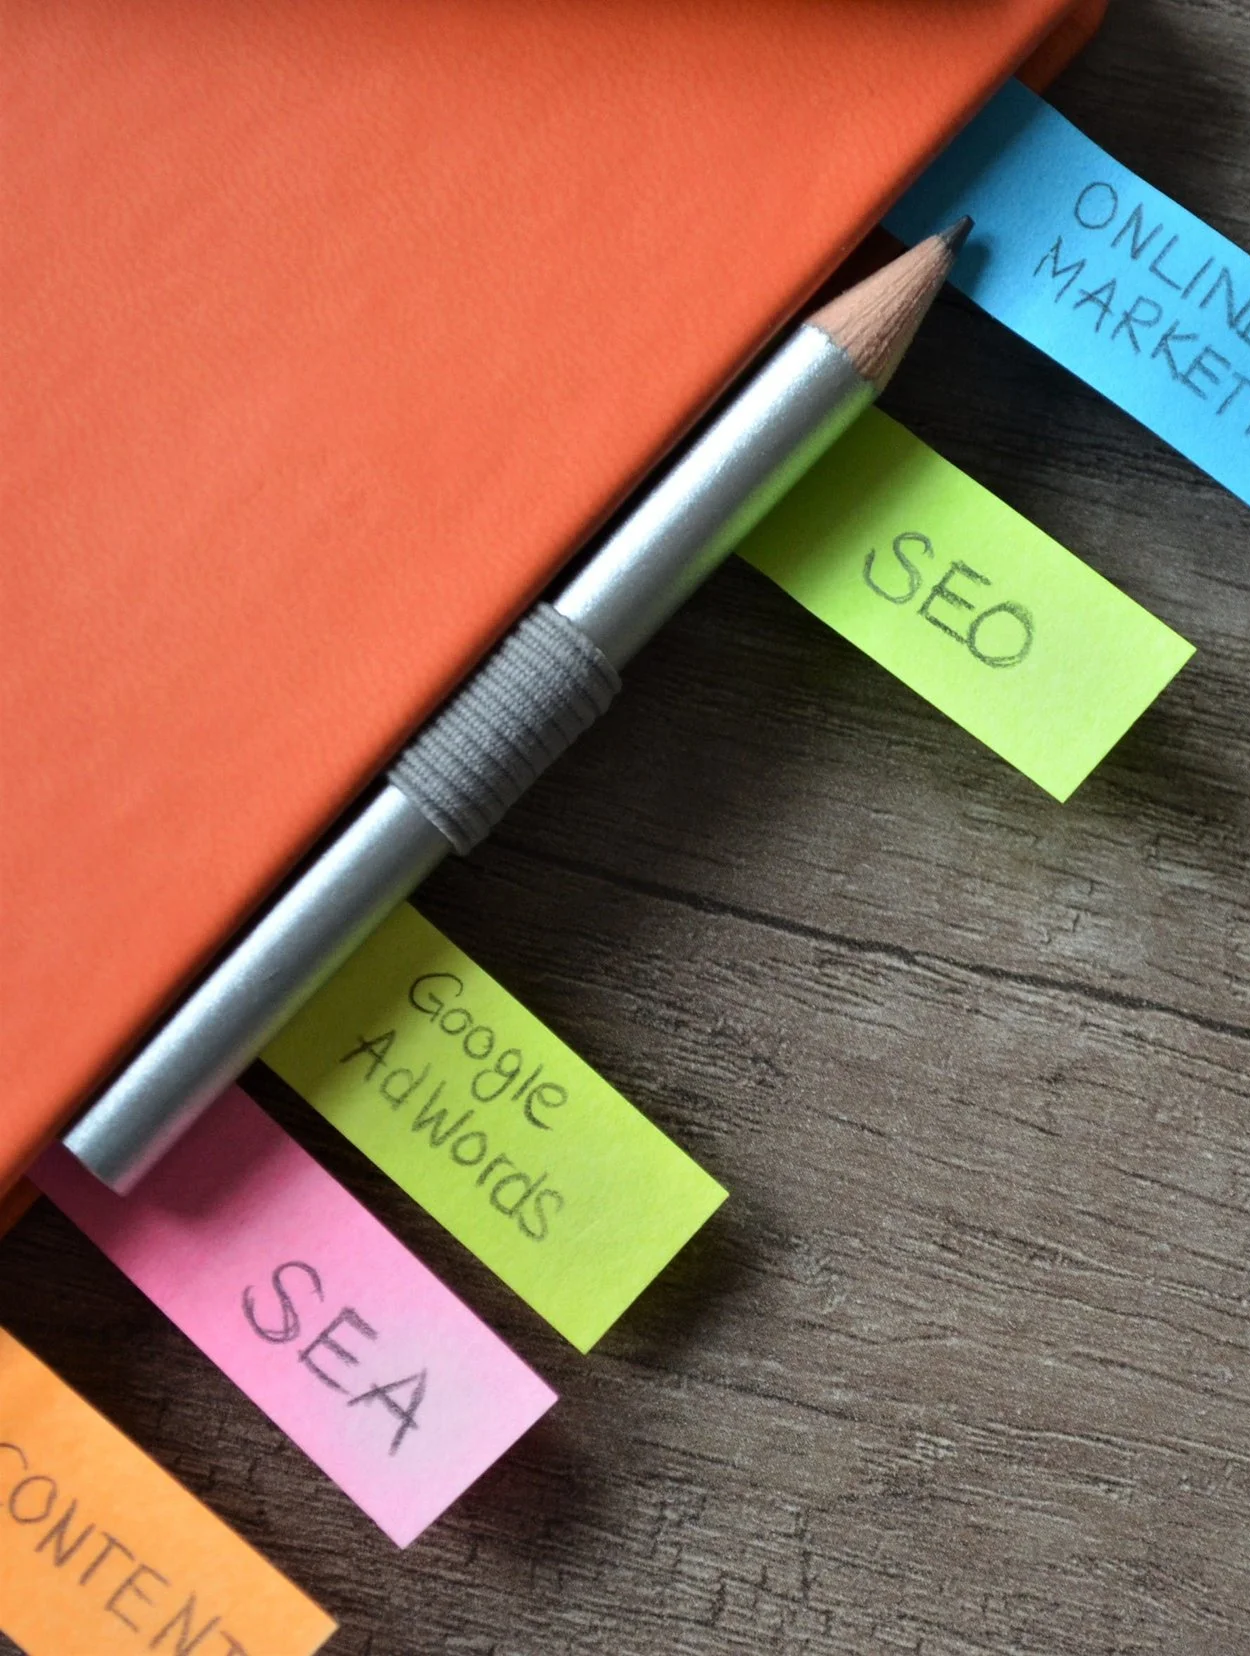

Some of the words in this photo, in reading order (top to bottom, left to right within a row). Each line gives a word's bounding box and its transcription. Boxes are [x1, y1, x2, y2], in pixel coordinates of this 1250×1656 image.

[862, 530, 1035, 669] SEO
[339, 1028, 565, 1243] AdWords
[407, 971, 568, 1131] Google
[241, 1260, 428, 1457] SEA
